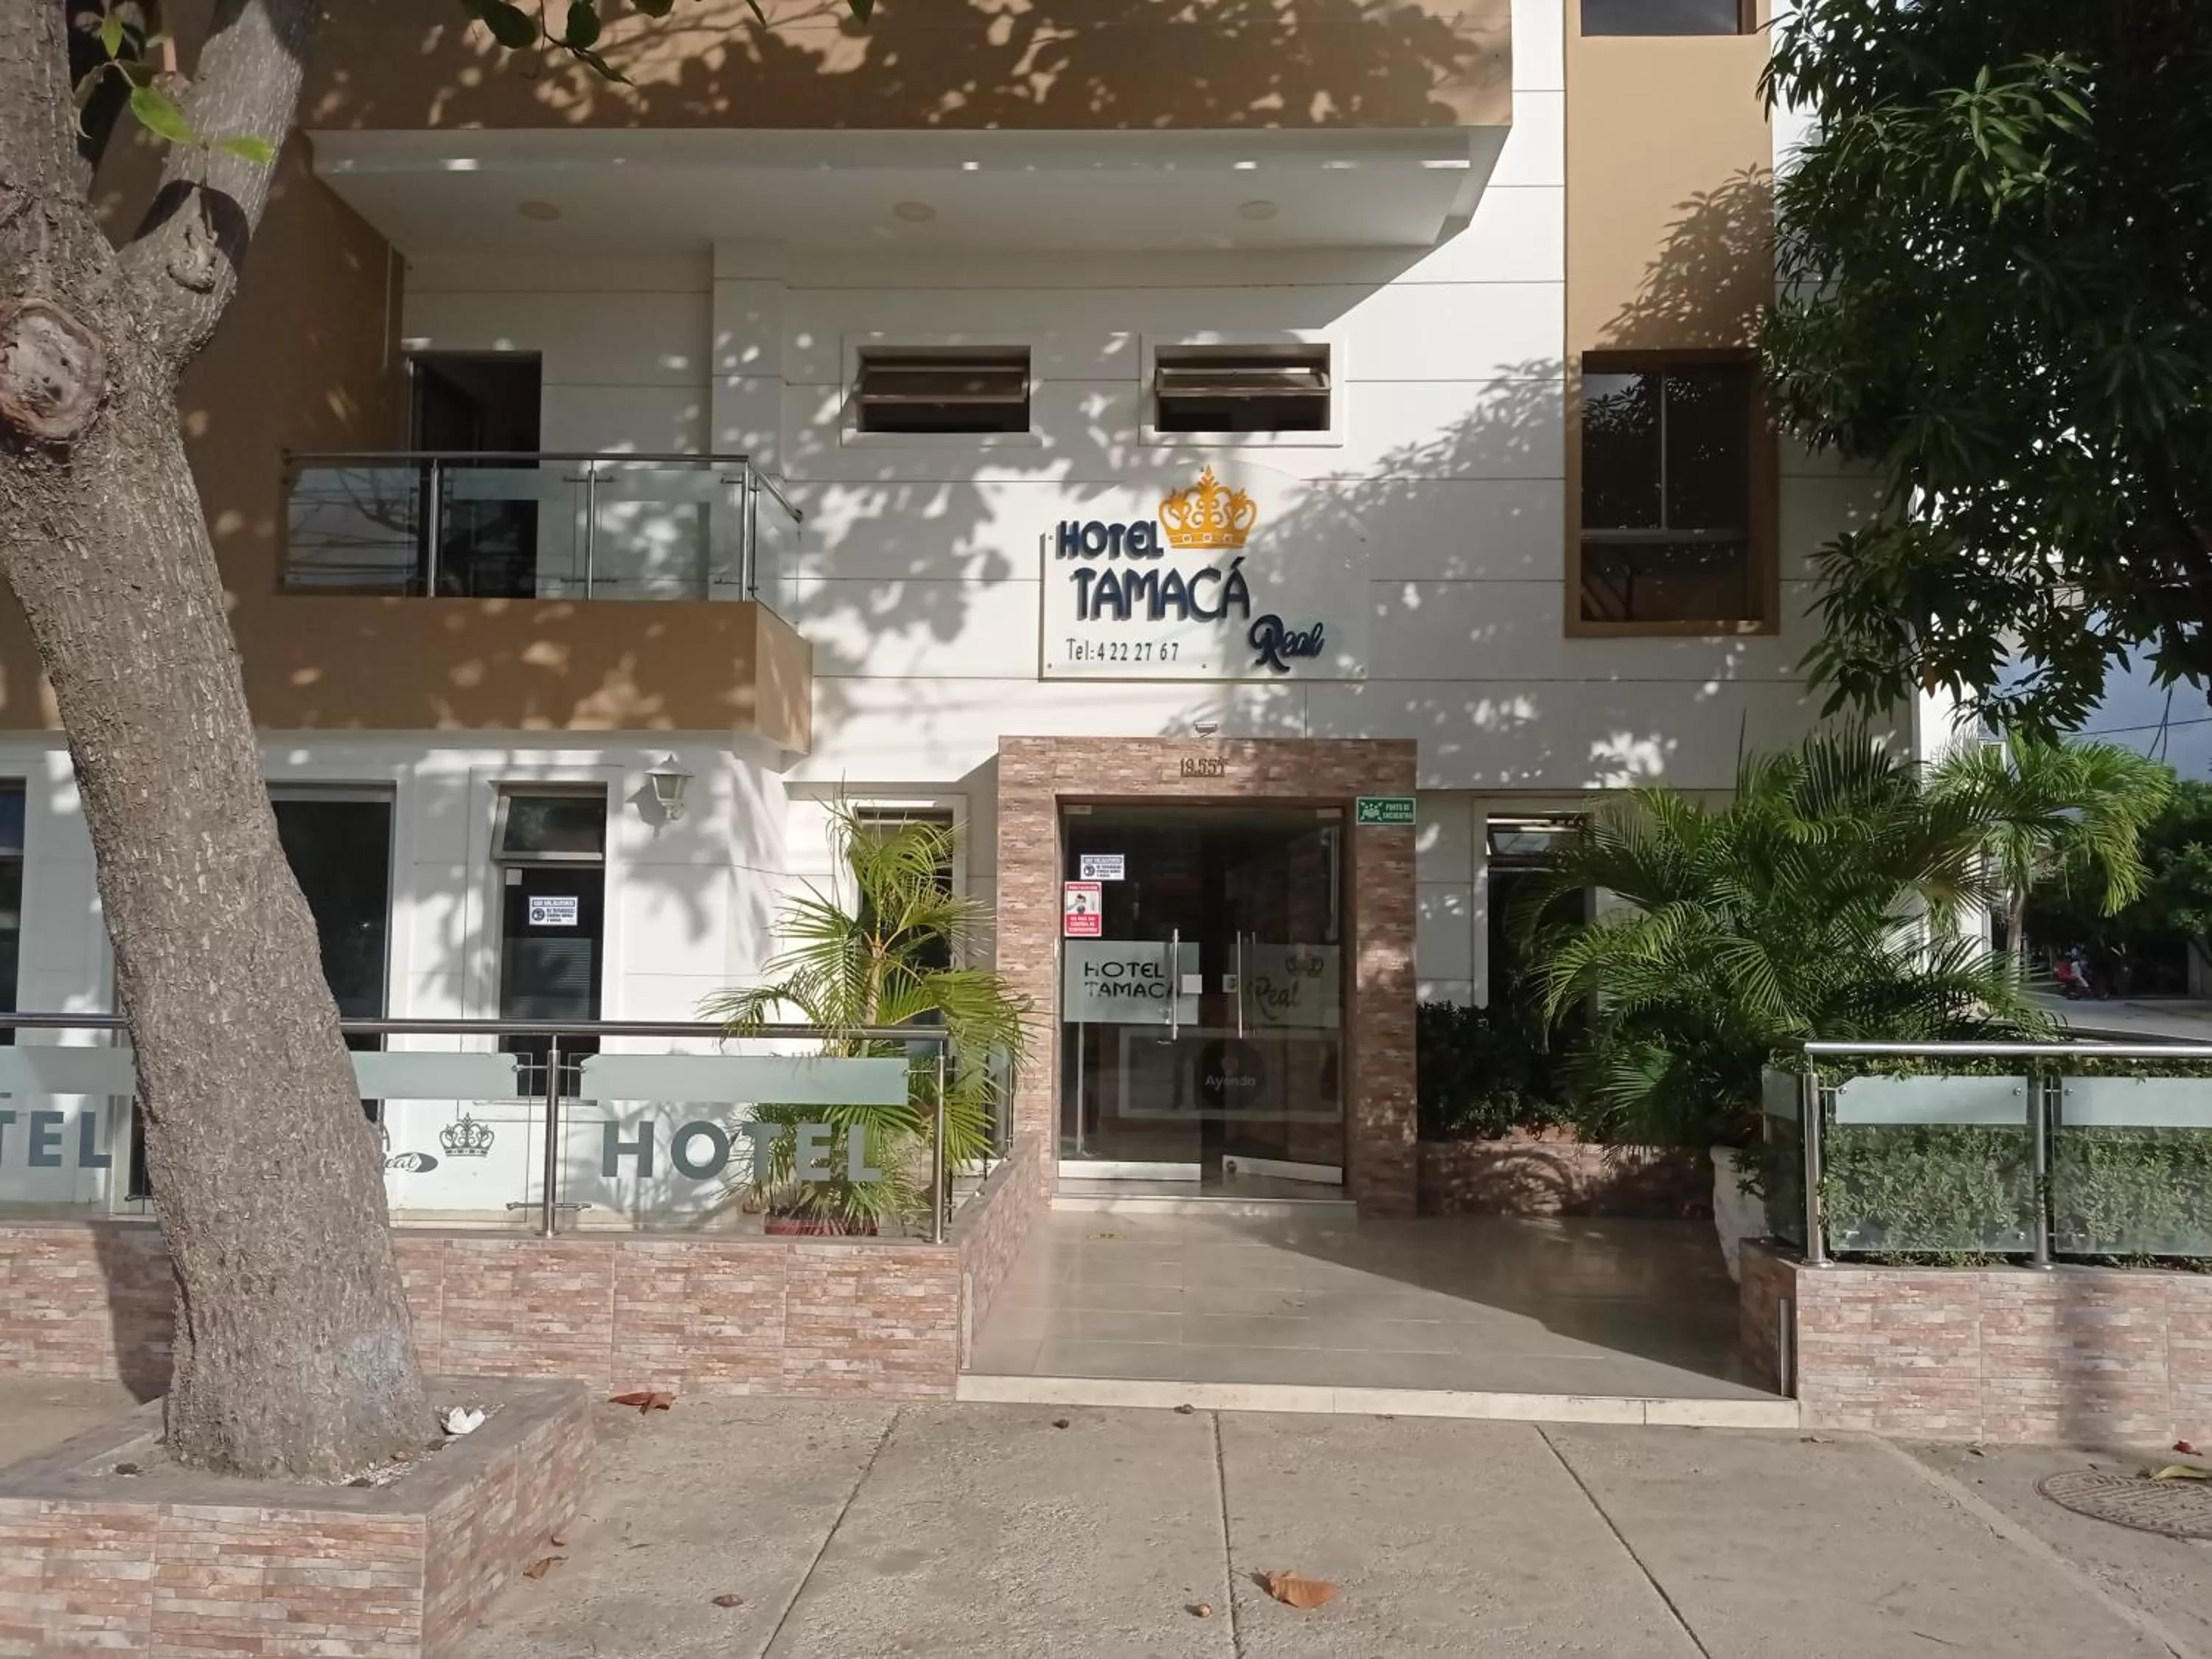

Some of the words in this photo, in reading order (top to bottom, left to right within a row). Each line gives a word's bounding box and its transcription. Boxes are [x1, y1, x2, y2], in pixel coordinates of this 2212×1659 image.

[1057, 520, 1164, 558] HOTEL
[1072, 557, 1250, 621] TAMACÁ
[1250, 614, 1324, 672] Real
[1085, 961, 1165, 978] HOTEL
[1247, 976, 1301, 1020] Real
[382, 1152, 420, 1169] eal
[602, 1120, 883, 1180] HOTEL
